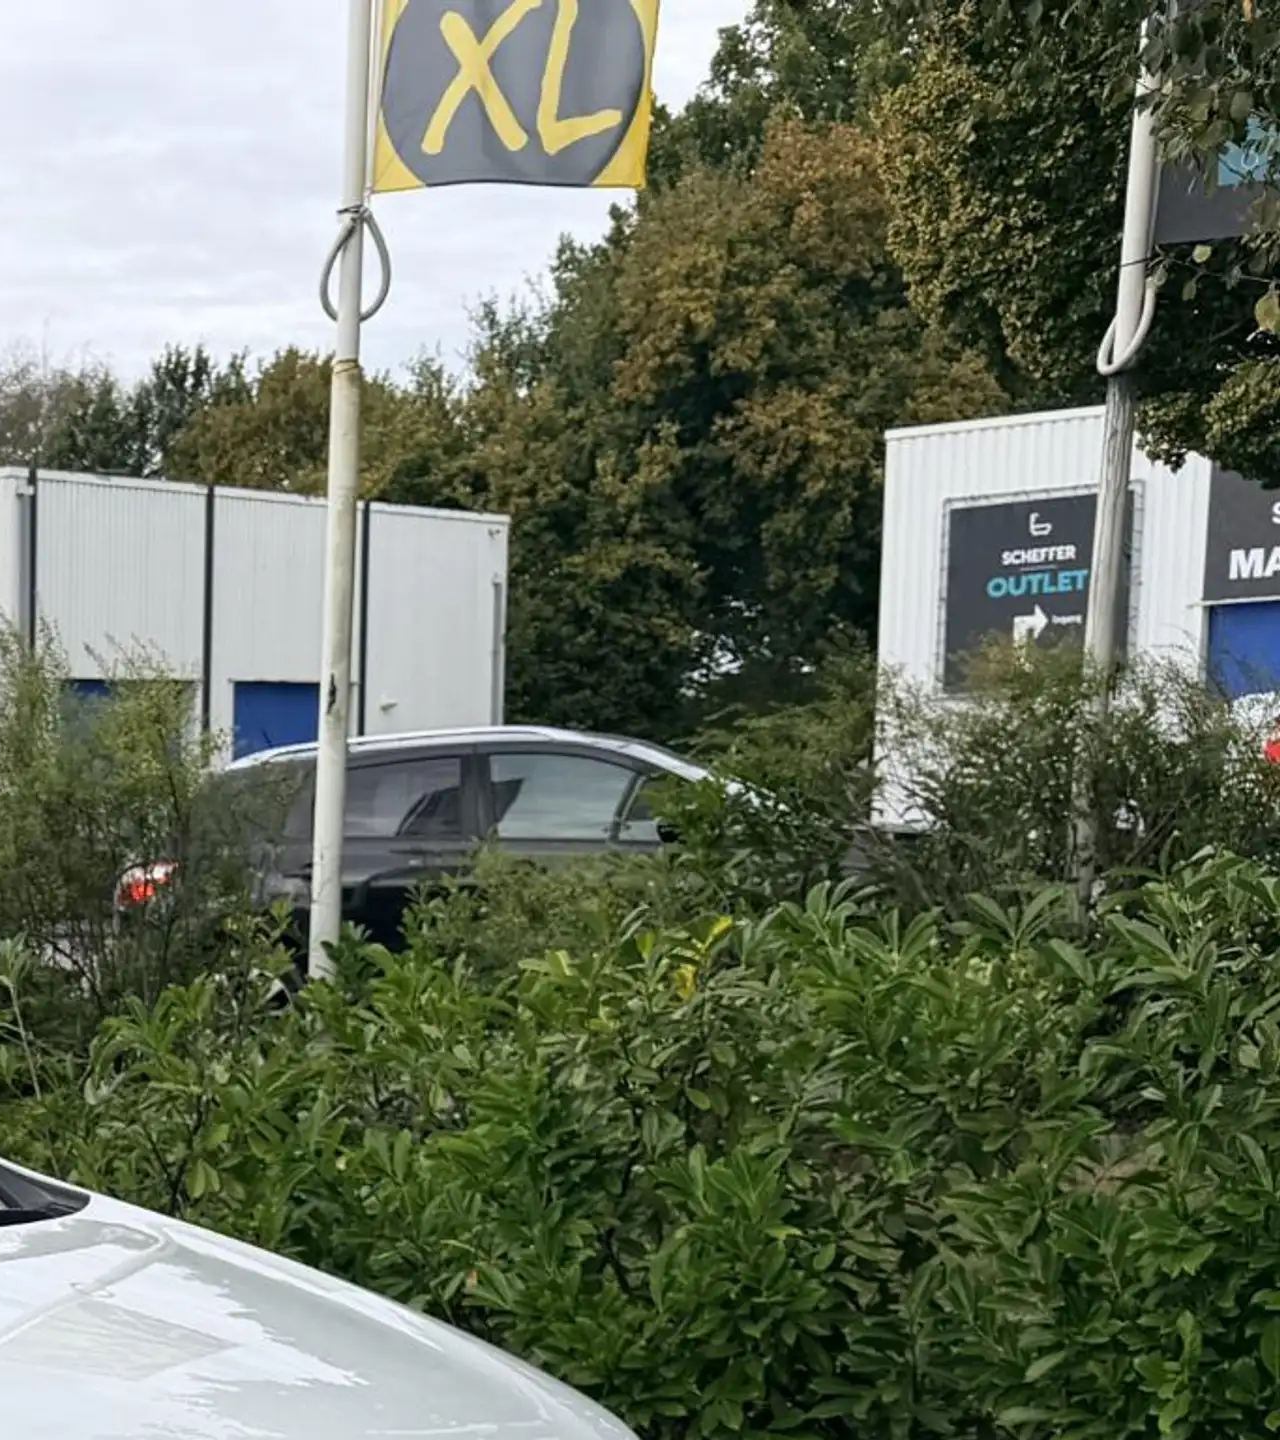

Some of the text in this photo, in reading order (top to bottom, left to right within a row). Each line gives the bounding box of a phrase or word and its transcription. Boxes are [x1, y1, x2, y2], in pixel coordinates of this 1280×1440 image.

[421, 0, 623, 156] XL
[1002, 545, 1076, 566] SCHEFFER
[986, 569, 1089, 598] OUTLET
